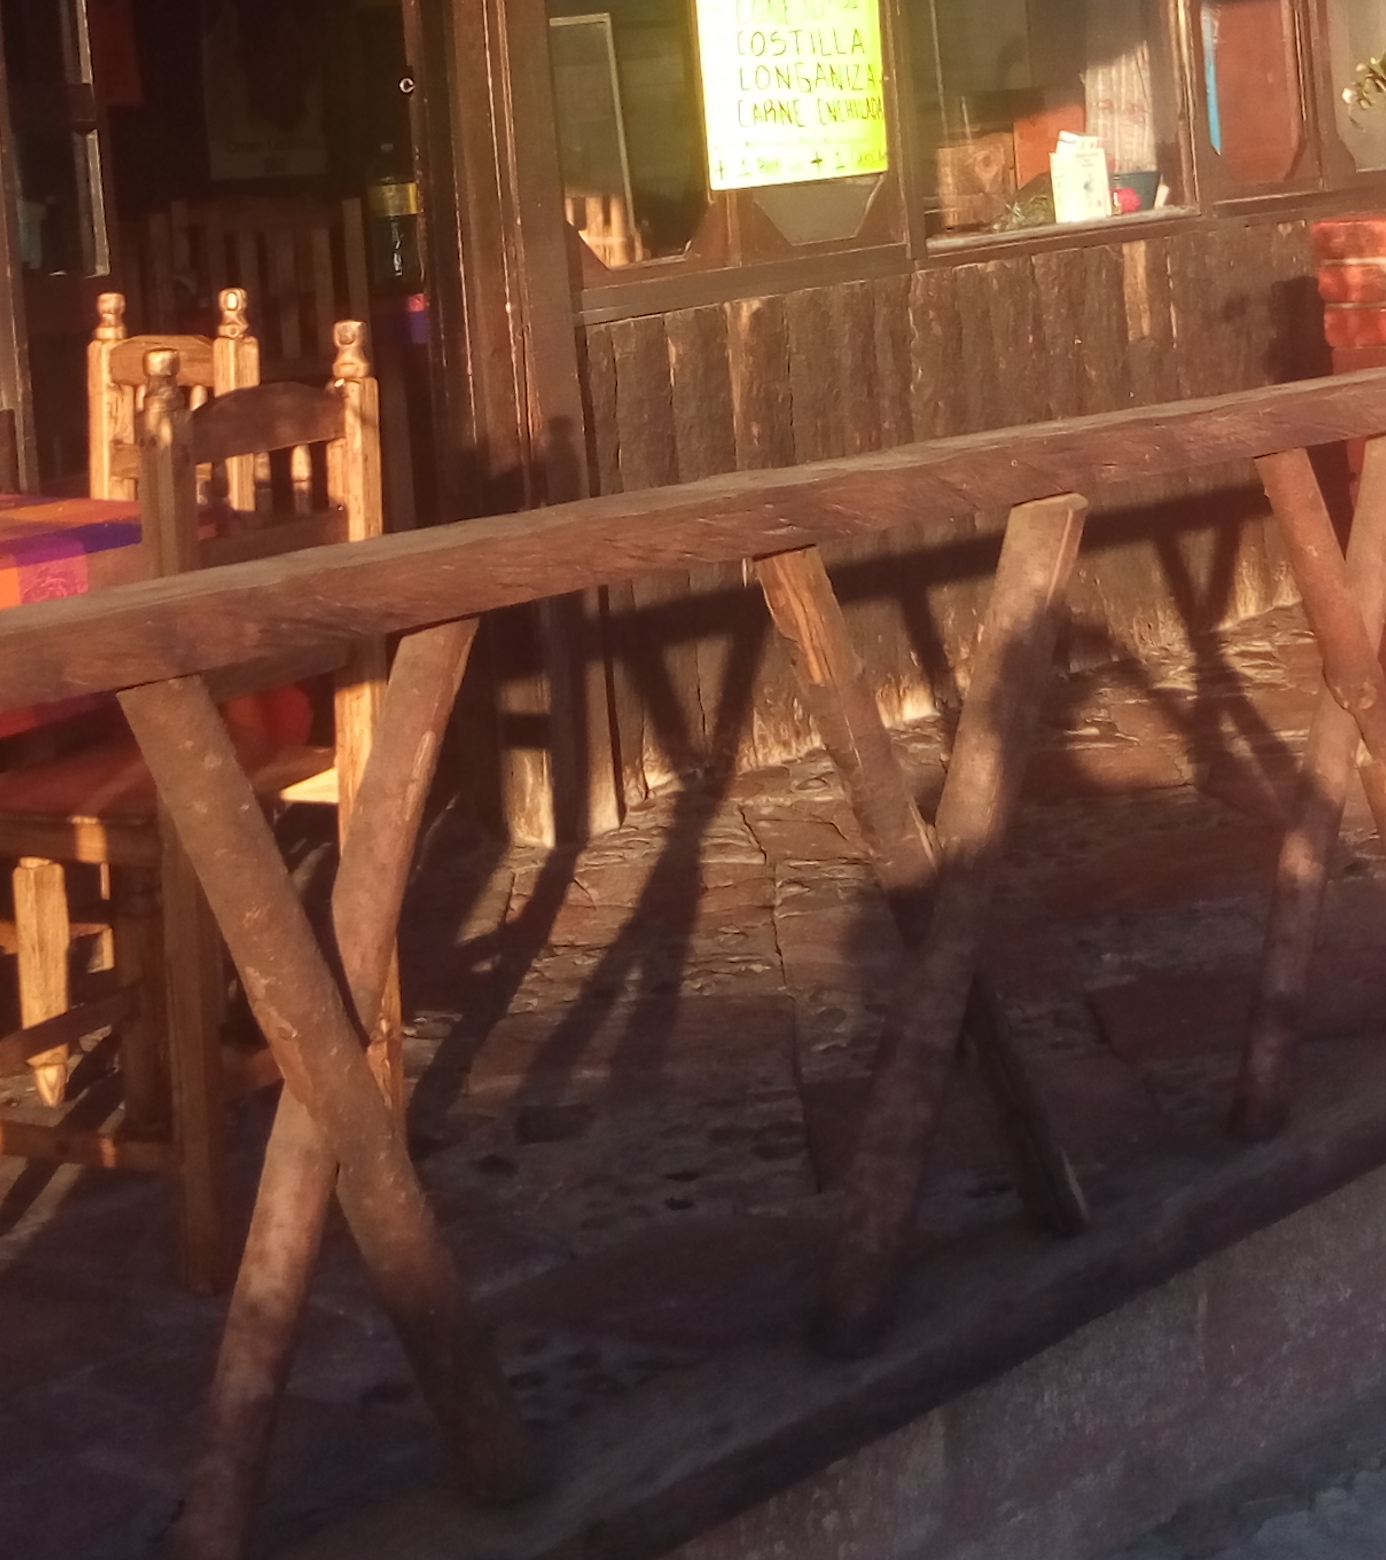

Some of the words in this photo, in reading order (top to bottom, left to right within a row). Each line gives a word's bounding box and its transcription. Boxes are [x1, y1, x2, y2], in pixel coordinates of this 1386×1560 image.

[737, 28, 865, 57] COSTILLA
[740, 62, 876, 94] LONGANIZA
[737, 98, 805, 128] CARNE
